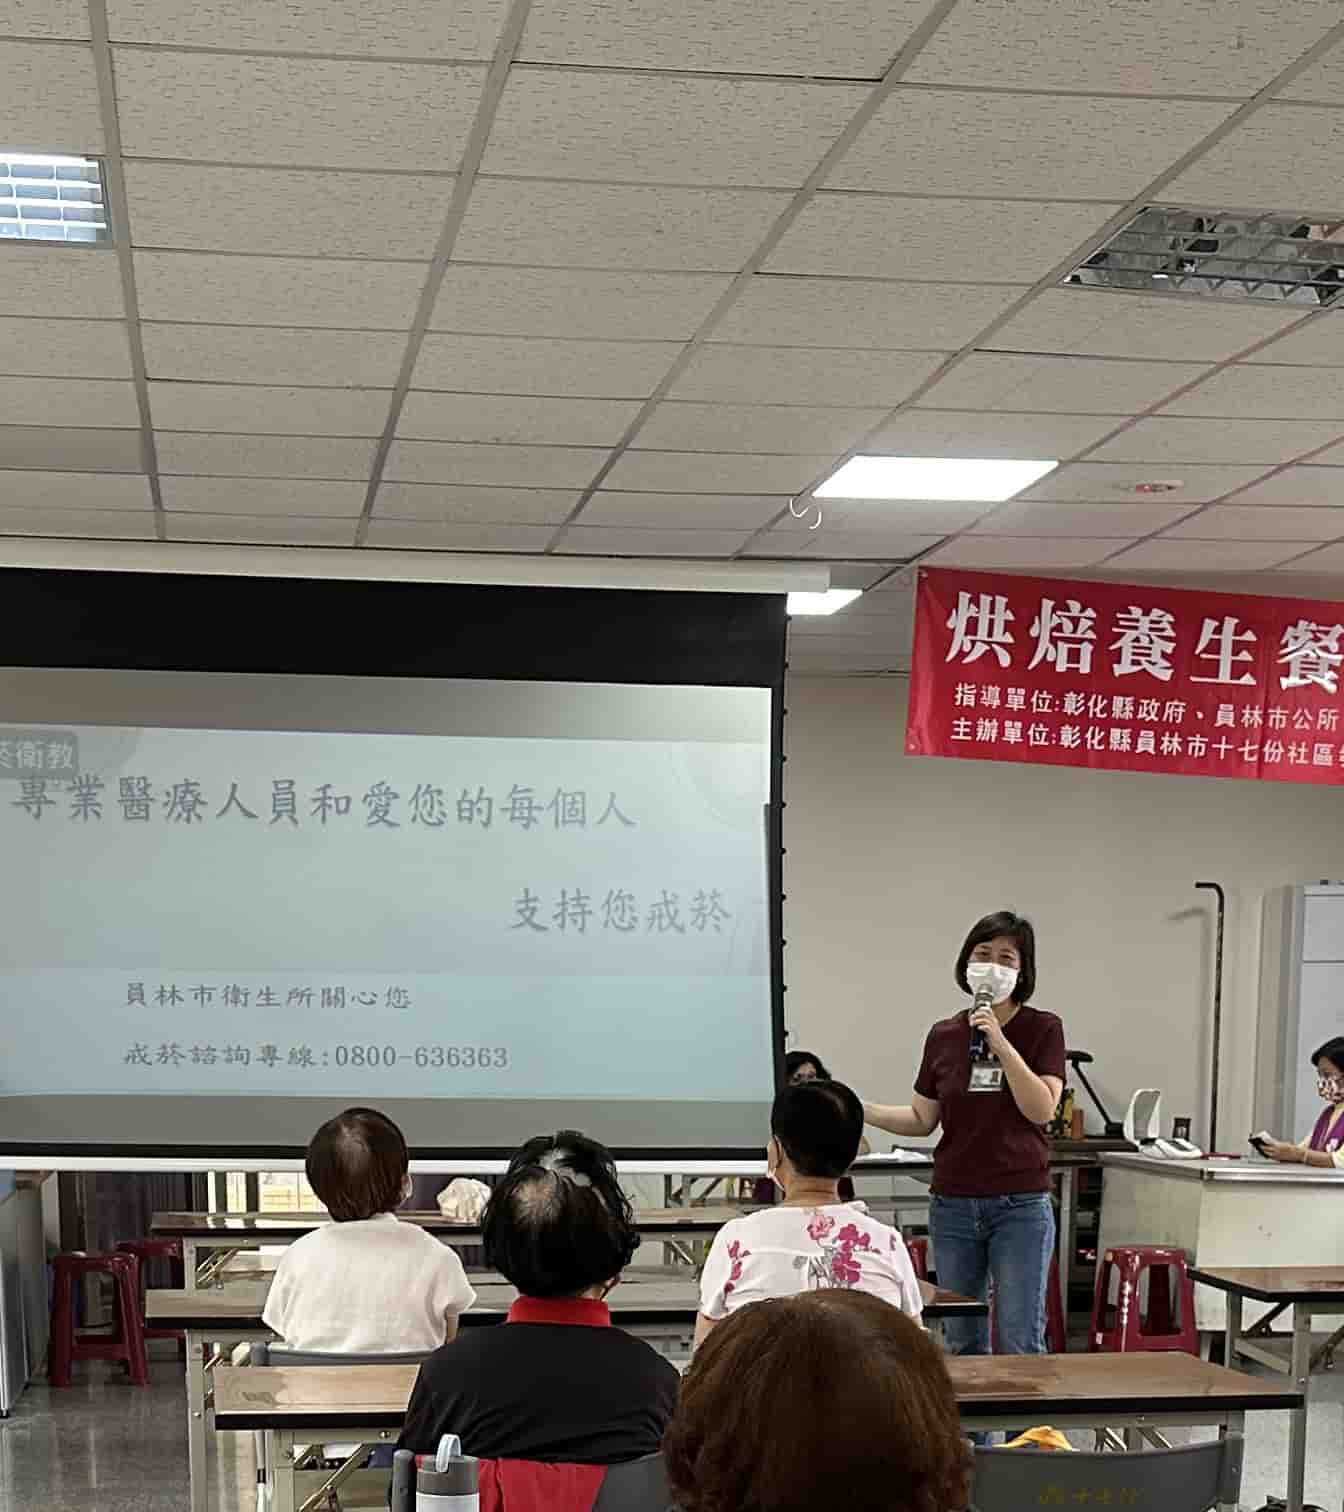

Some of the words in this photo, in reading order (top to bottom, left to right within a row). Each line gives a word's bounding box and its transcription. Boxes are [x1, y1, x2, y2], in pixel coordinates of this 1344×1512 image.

[11, 774, 638, 830] 專業醫療人員和愛您的每個人
[509, 887, 733, 936] 支持您戒菸
[125, 981, 413, 1011] 員林市衛生所關心您
